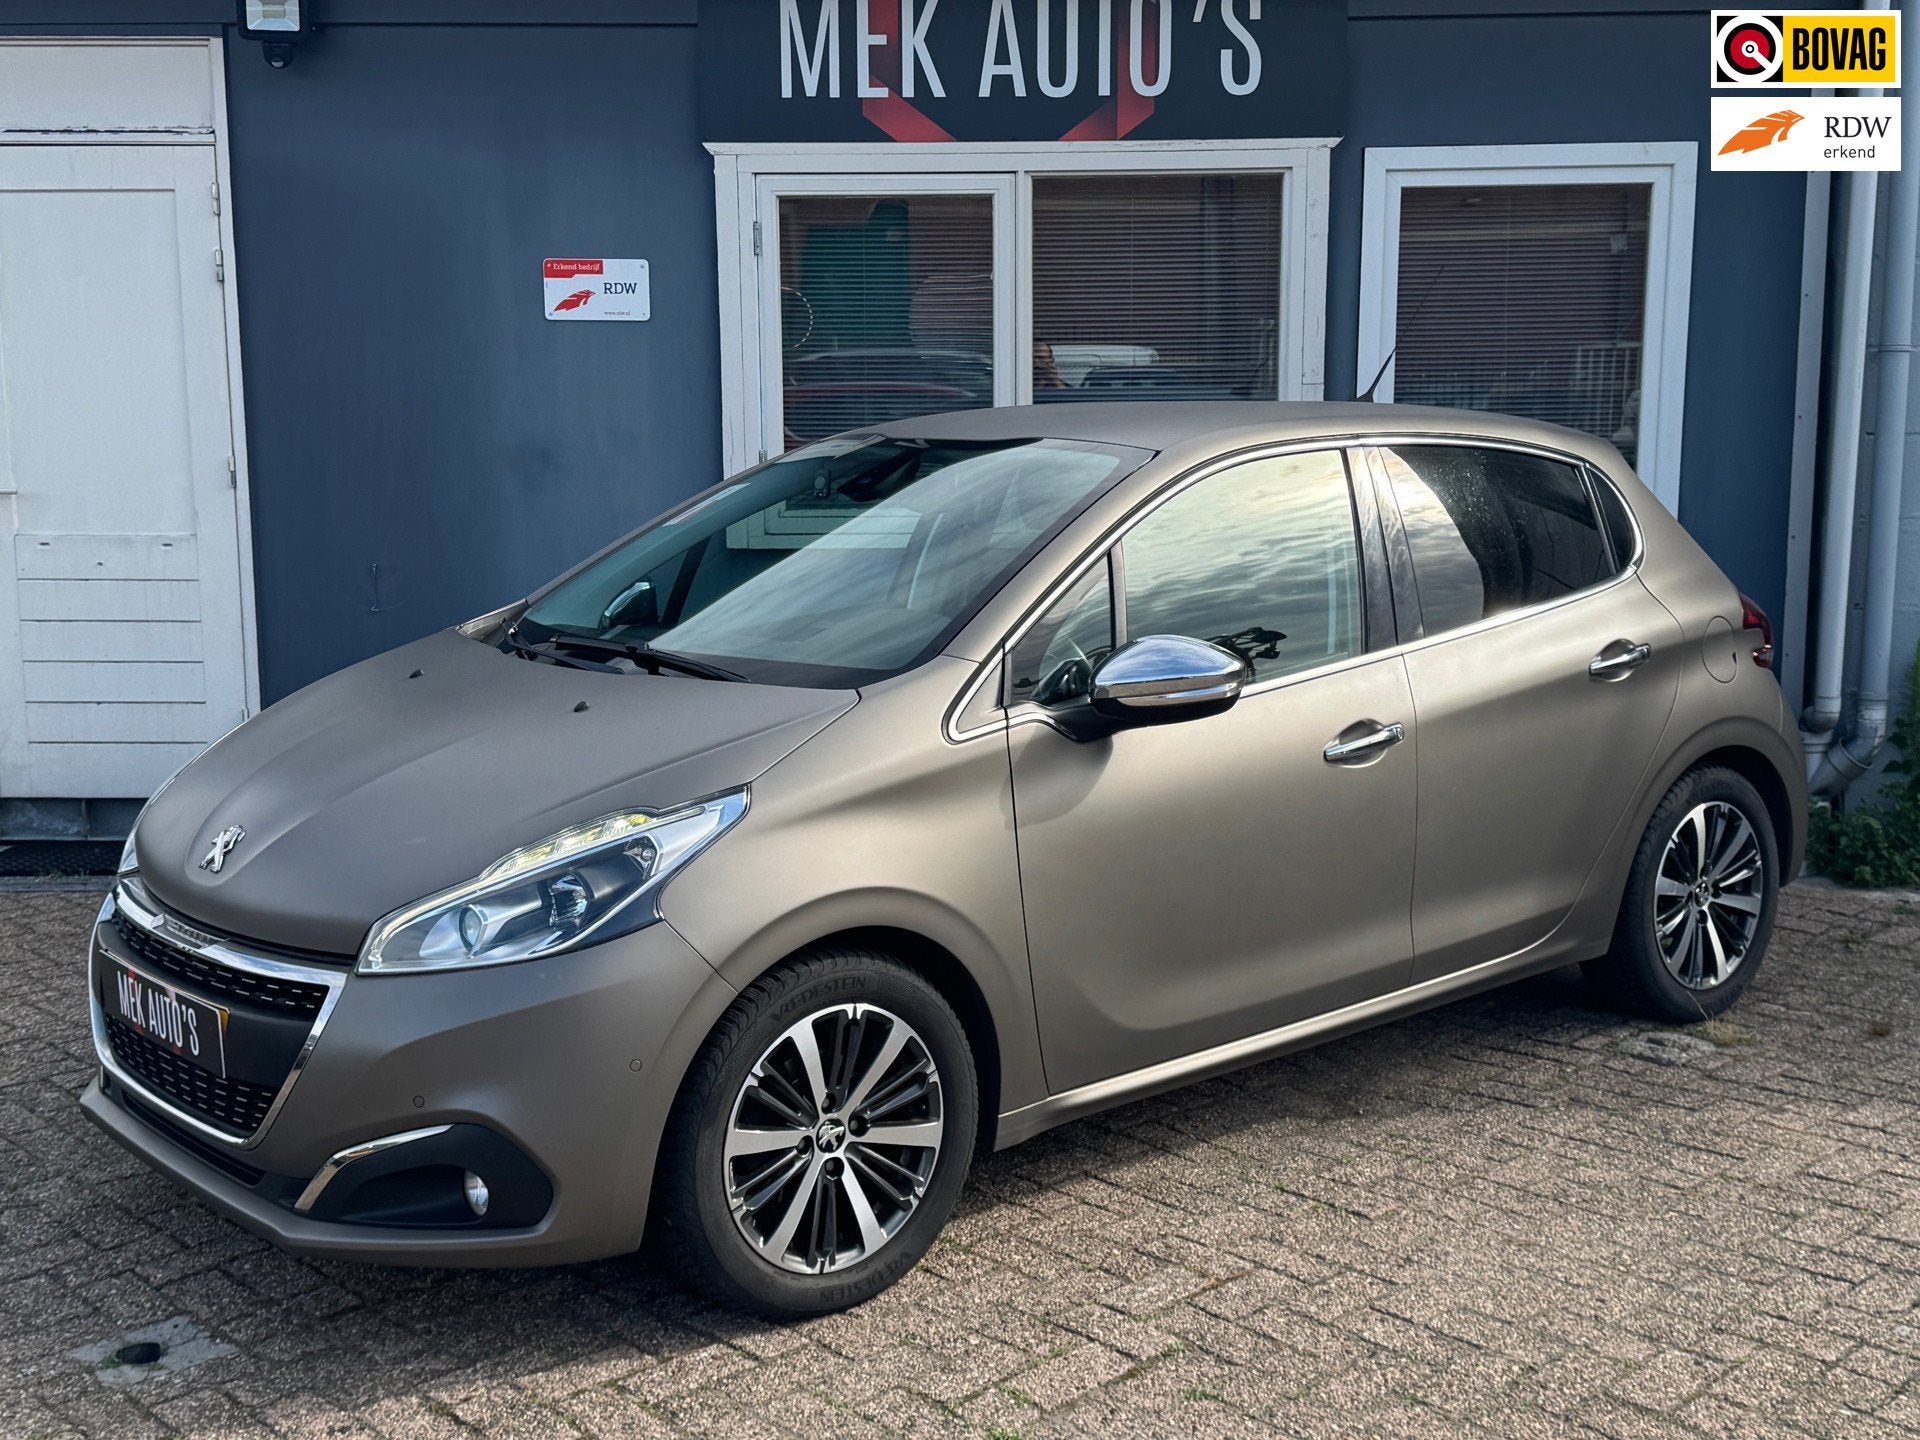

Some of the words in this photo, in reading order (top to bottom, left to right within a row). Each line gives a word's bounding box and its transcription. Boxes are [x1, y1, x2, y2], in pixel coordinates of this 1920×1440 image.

[780, 0, 946, 99] MEK
[578, 262, 601, 272] bedrijf
[603, 282, 637, 295] RDW
[117, 970, 146, 1028] MEK
[148, 988, 199, 1056] AUTO'S
